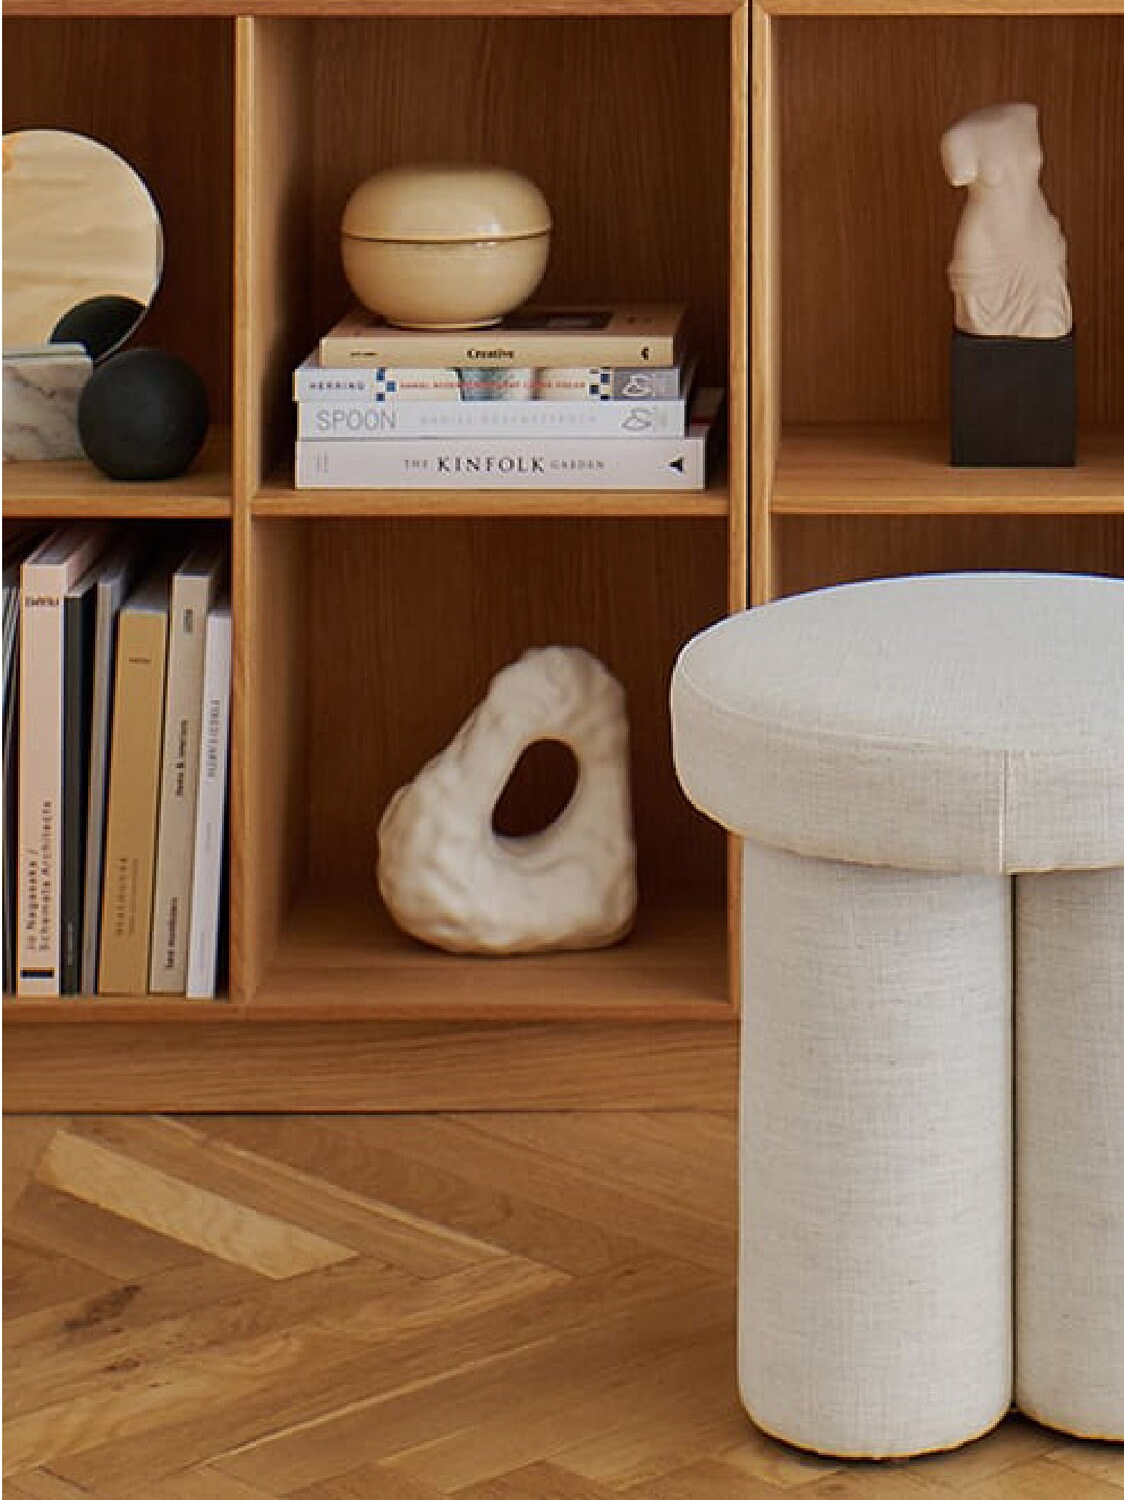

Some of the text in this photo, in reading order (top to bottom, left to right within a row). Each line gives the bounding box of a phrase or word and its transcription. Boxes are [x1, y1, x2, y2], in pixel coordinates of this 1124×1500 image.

[315, 408, 397, 431] SPOON
[403, 456, 606, 473] THE KINFOLK GARDEN
